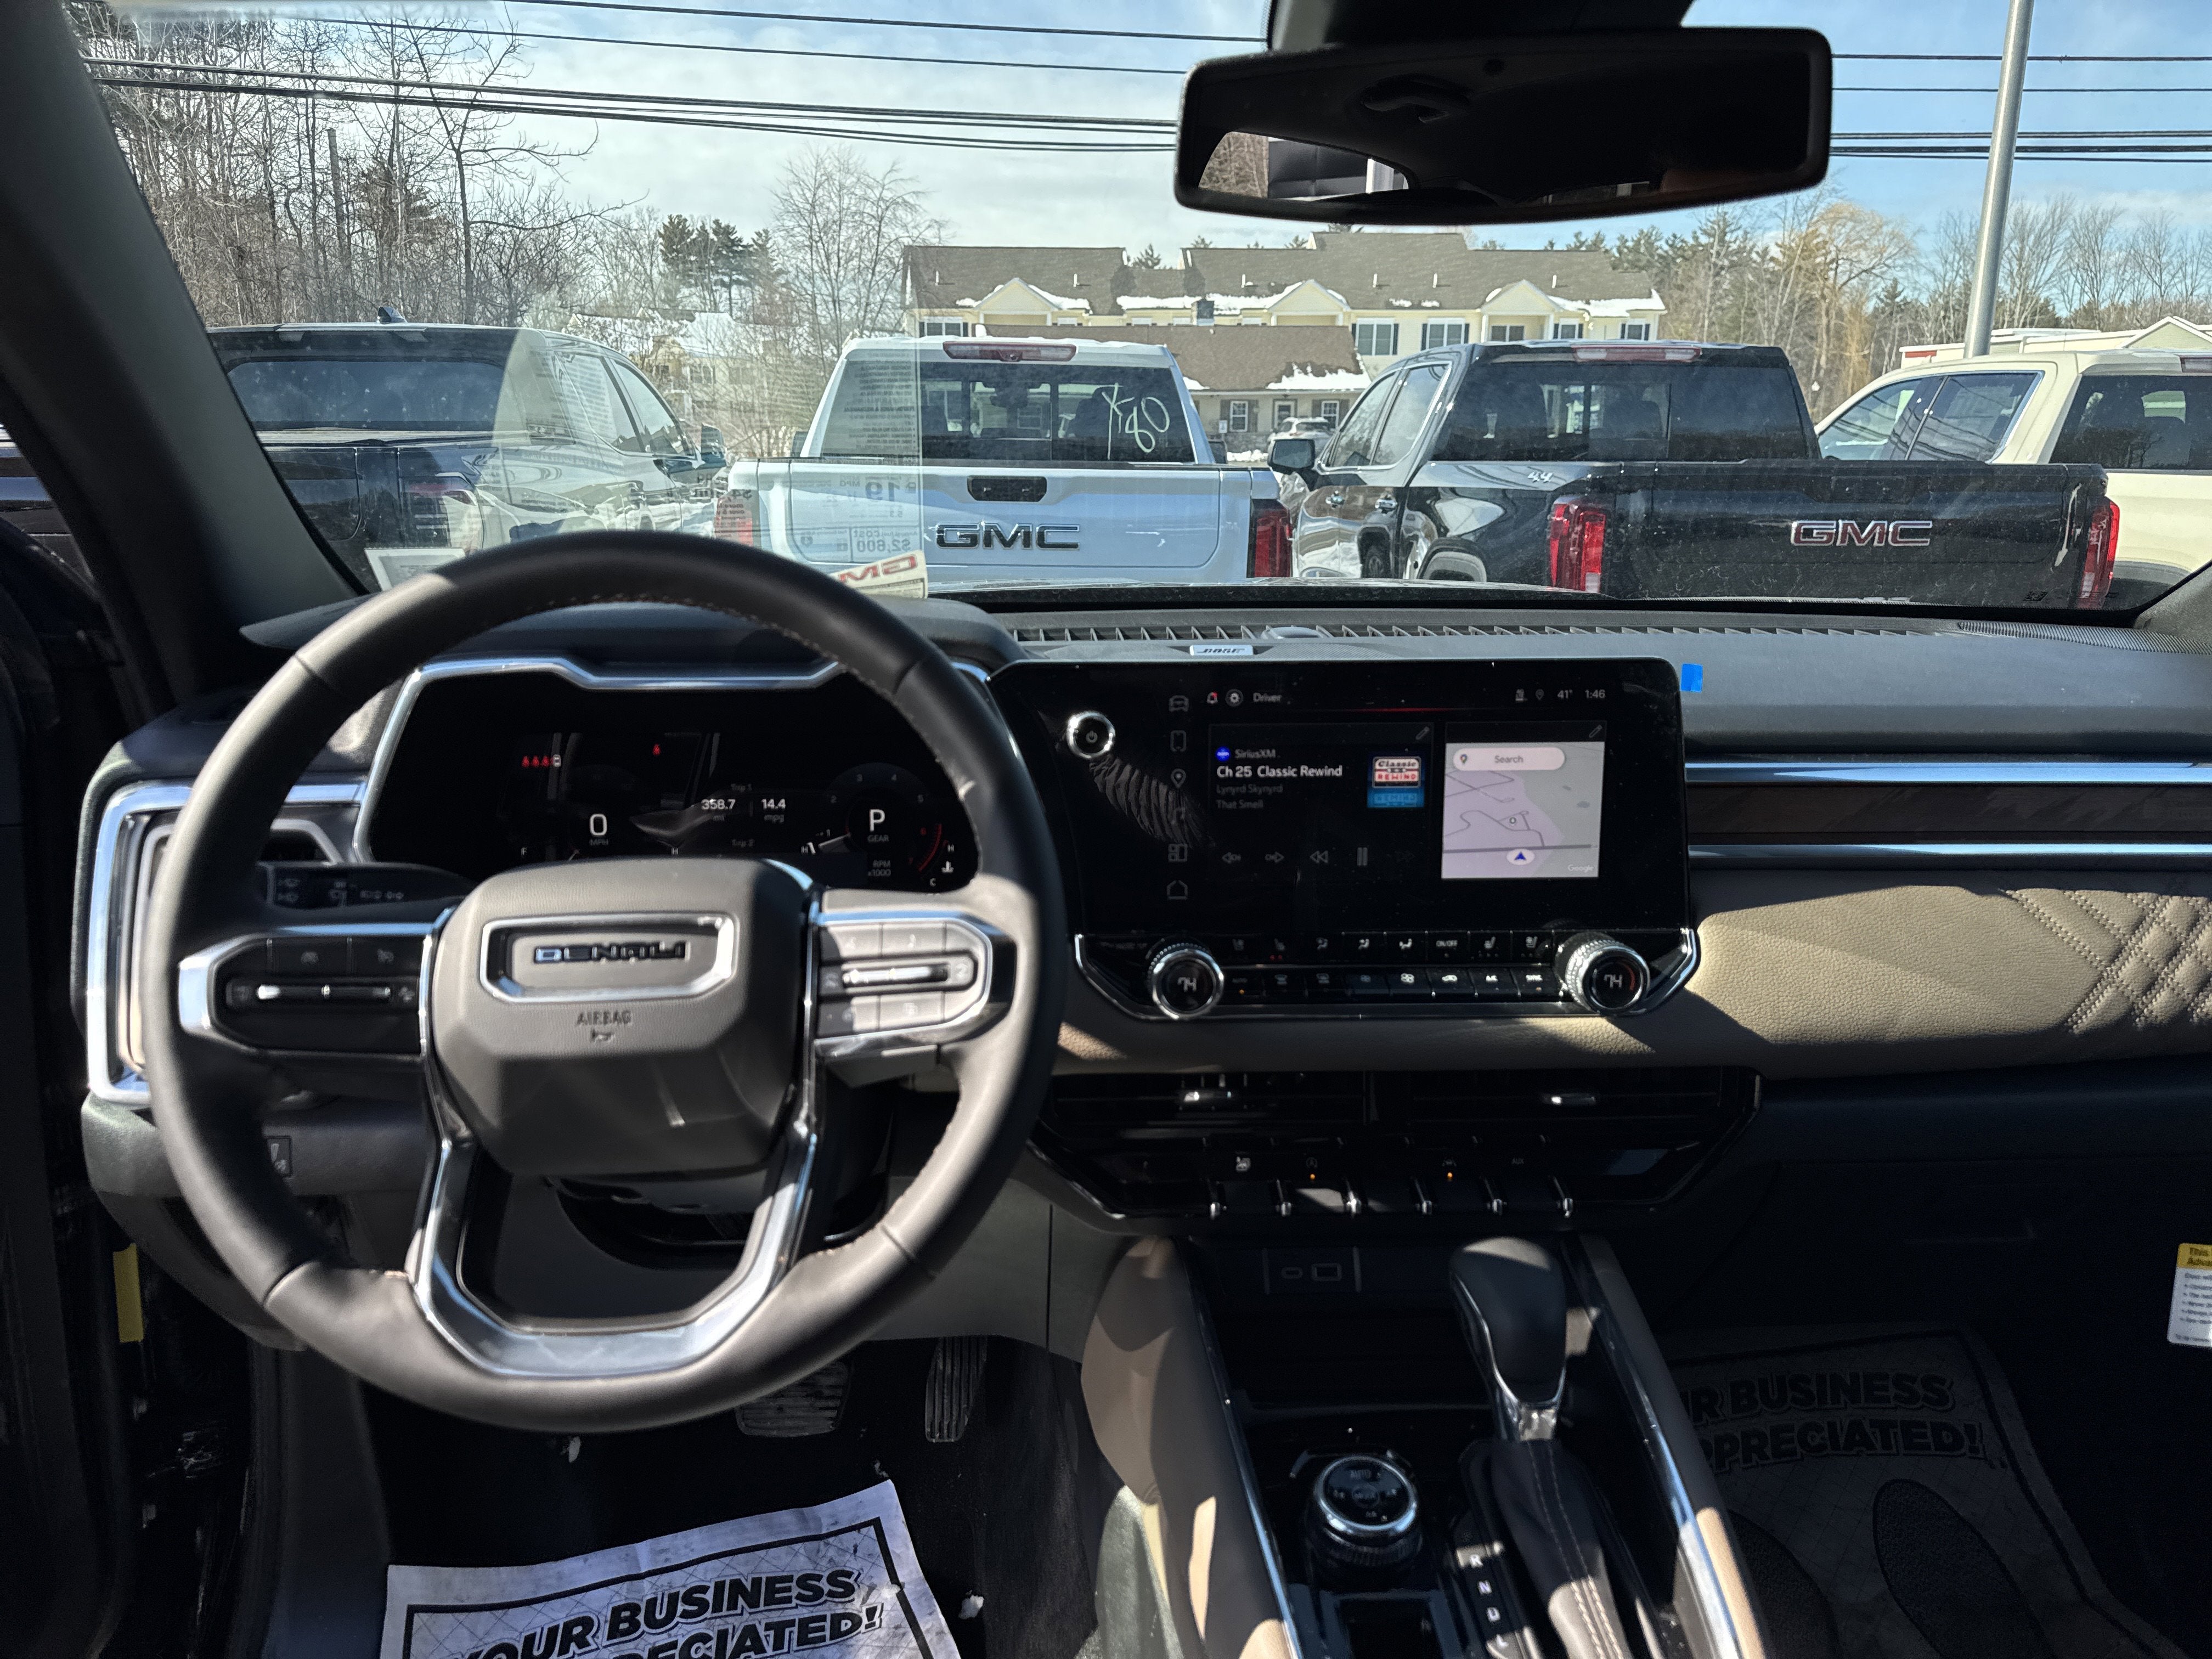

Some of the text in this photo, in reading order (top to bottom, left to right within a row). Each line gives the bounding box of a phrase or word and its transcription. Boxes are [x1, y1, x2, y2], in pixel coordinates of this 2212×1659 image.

[935, 522, 1081, 550] GMC
[1791, 519, 1933, 547] GMC
[1253, 692, 1282, 702] Driver
[1584, 689, 1606, 699] 1:46
[1234, 748, 1277, 759] SiriusXM
[1494, 755, 1524, 764] Search
[1216, 765, 1344, 778] Ch 25 Classic Rewind
[856, 774, 864, 782] 3
[891, 774, 898, 782] 4
[1248, 784, 1284, 795] Skynyrd
[701, 798, 736, 810] 358.7
[760, 798, 786, 810] 14.4
[830, 795, 838, 804] 2
[917, 794, 924, 804] 5
[1216, 799, 1264, 809] That Smell
[589, 812, 608, 837] 0
[868, 808, 886, 833] P
[589, 838, 609, 847] MPH
[867, 835, 890, 843] GEAR
[872, 860, 891, 868] RPM
[1567, 864, 1594, 873] Google
[533, 940, 687, 964] DENALI
[1603, 974, 1623, 989] 74
[576, 1010, 633, 1025] AIRBAG
[1730, 1372, 1953, 1415] BUSINESS
[1470, 1554, 1484, 1568] R
[1477, 1579, 1493, 1595] N
[454, 1569, 860, 1659] OUR BUSINESS
[612, 1606, 879, 1659] ECIATED!
